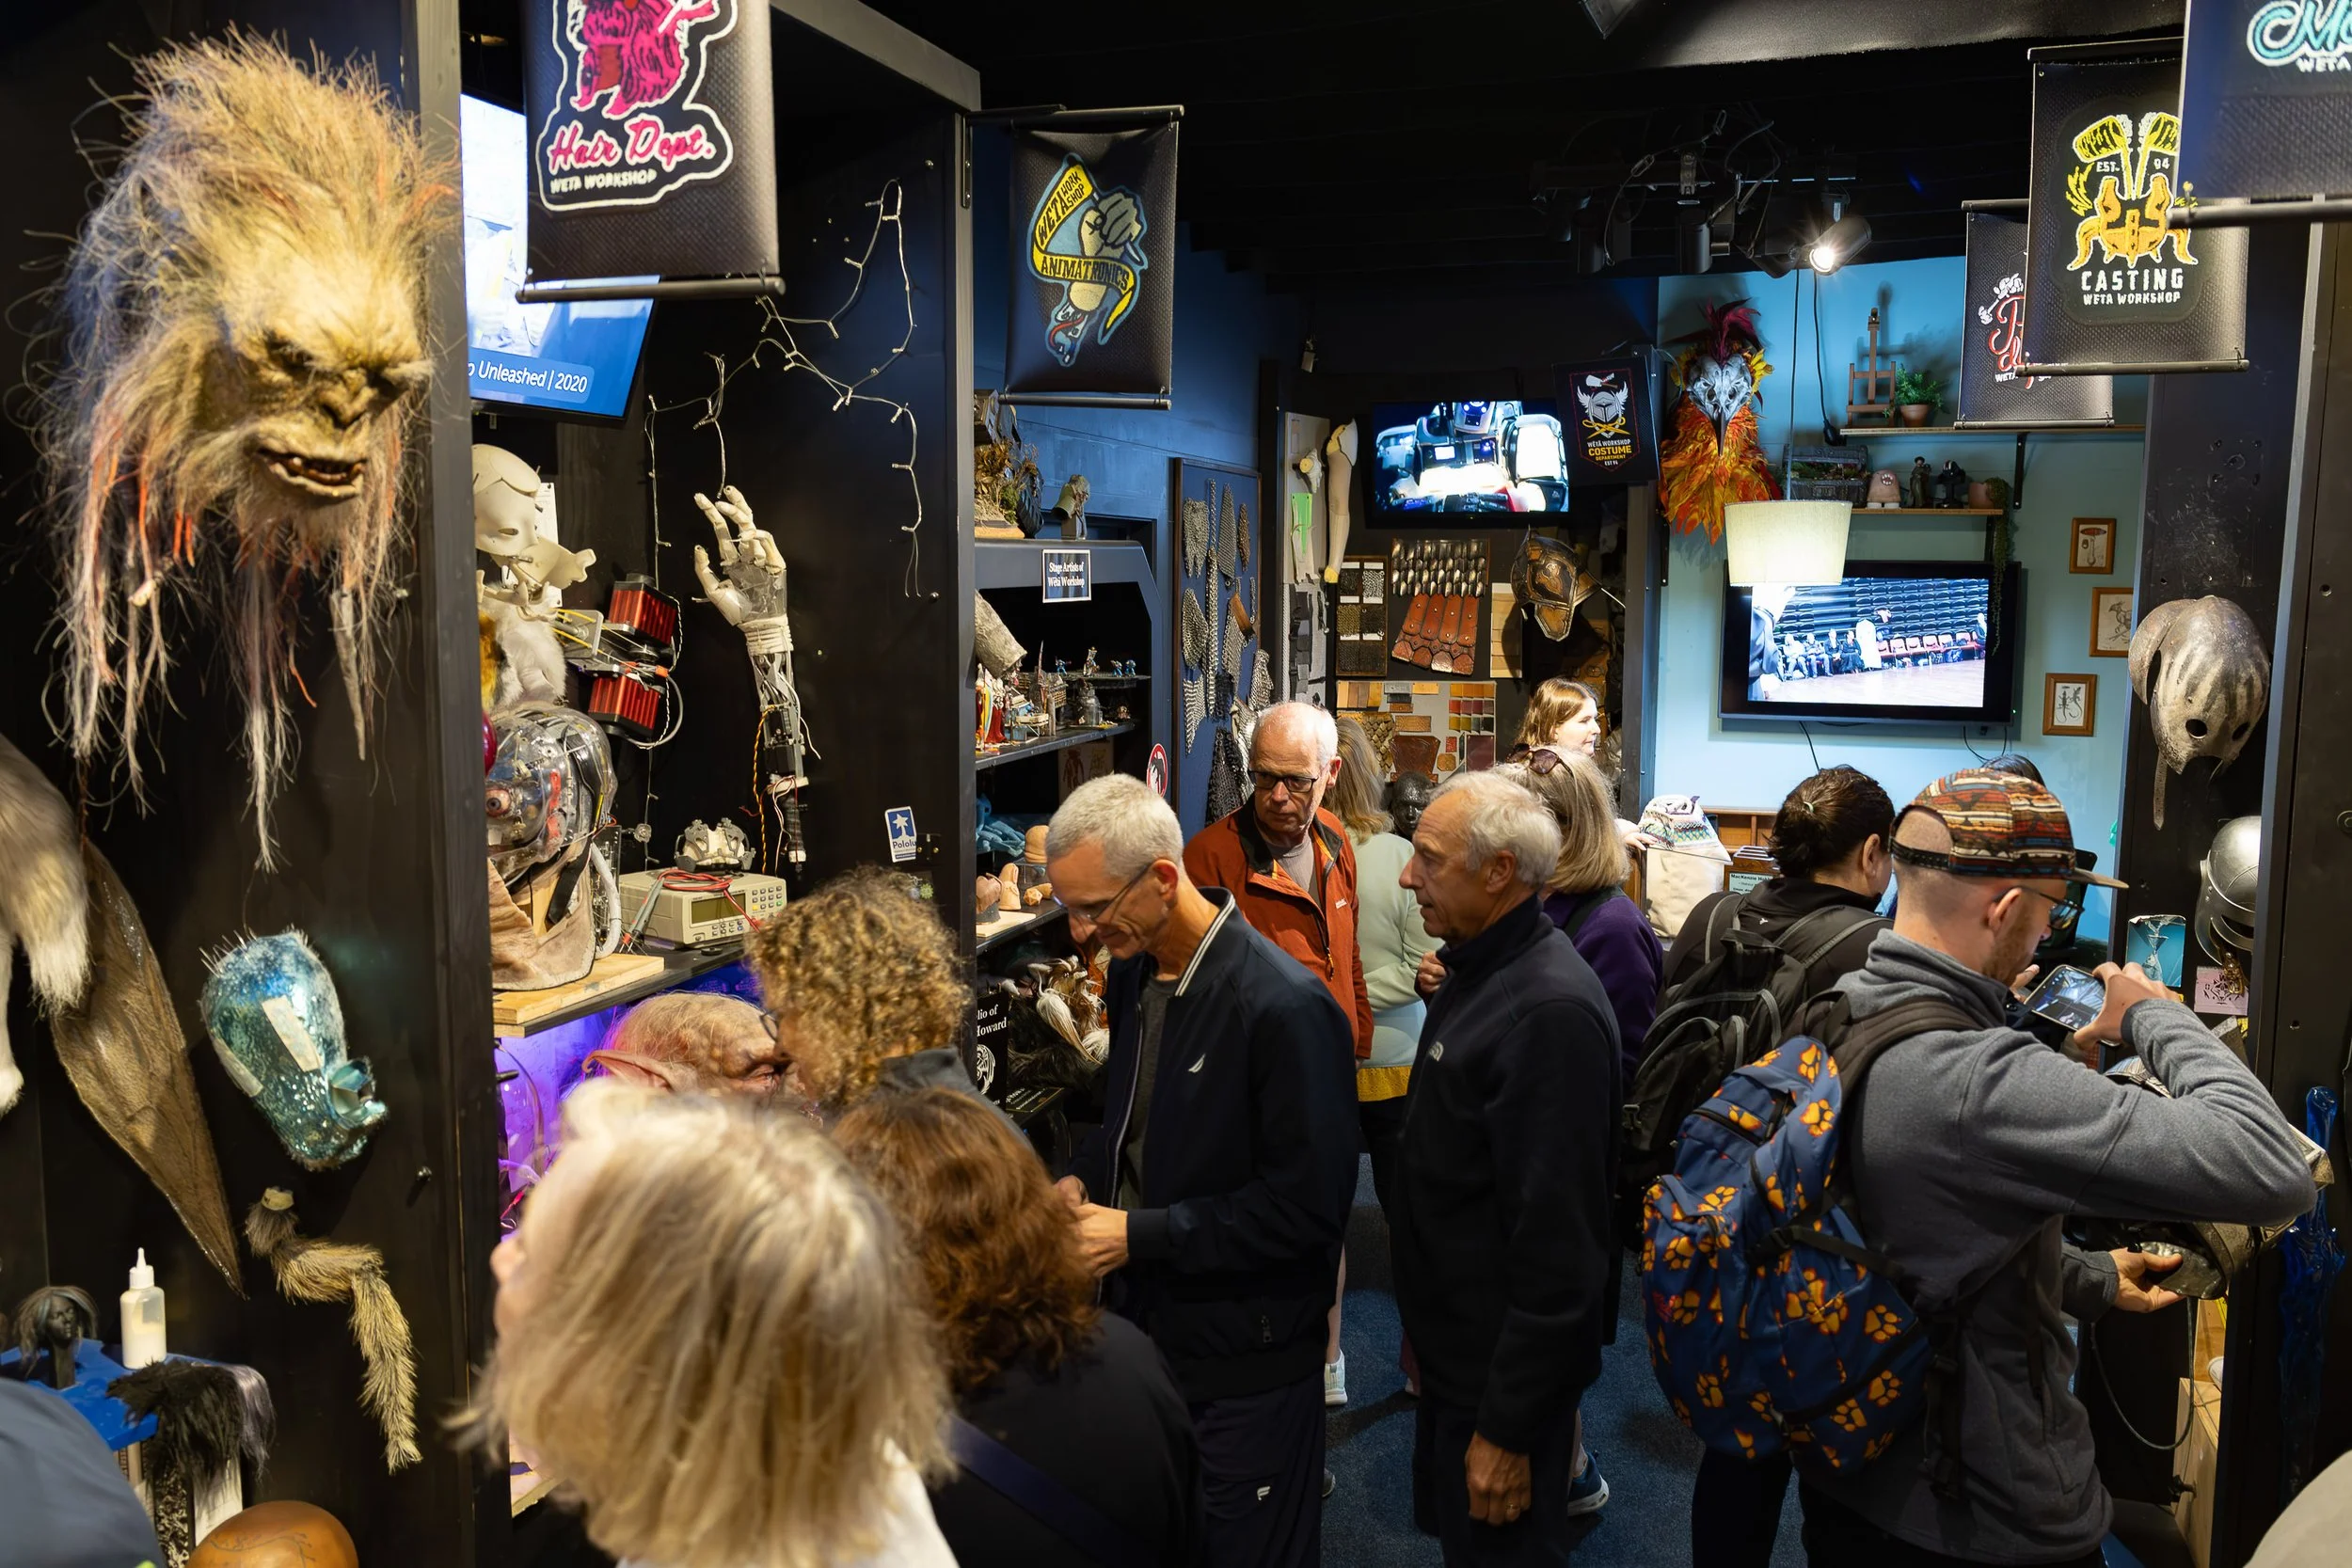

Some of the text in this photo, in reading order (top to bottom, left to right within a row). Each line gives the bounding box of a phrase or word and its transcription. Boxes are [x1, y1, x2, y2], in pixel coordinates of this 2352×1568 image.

[548, 116, 715, 173] Hair Dept.
[2153, 157, 2170, 170] 94
[550, 168, 658, 194] WETA WORKSHOP
[1067, 183, 1086, 208] SHOP
[1038, 191, 1069, 246] WETA
[1041, 256, 1130, 291] ANIMATRONICS
[2080, 268, 2185, 293] CASTING
[2083, 291, 2182, 306] WETA WORKSHOP
[478, 360, 548, 388] Unleashed
[554, 372, 588, 393] 2020
[1588, 445, 1632, 456] COSTUME
[1602, 438, 1630, 447] WORKSHOP
[1061, 575, 1085, 588] Workshop
[892, 839, 917, 849] Pololu
[989, 1004, 999, 1016] of
